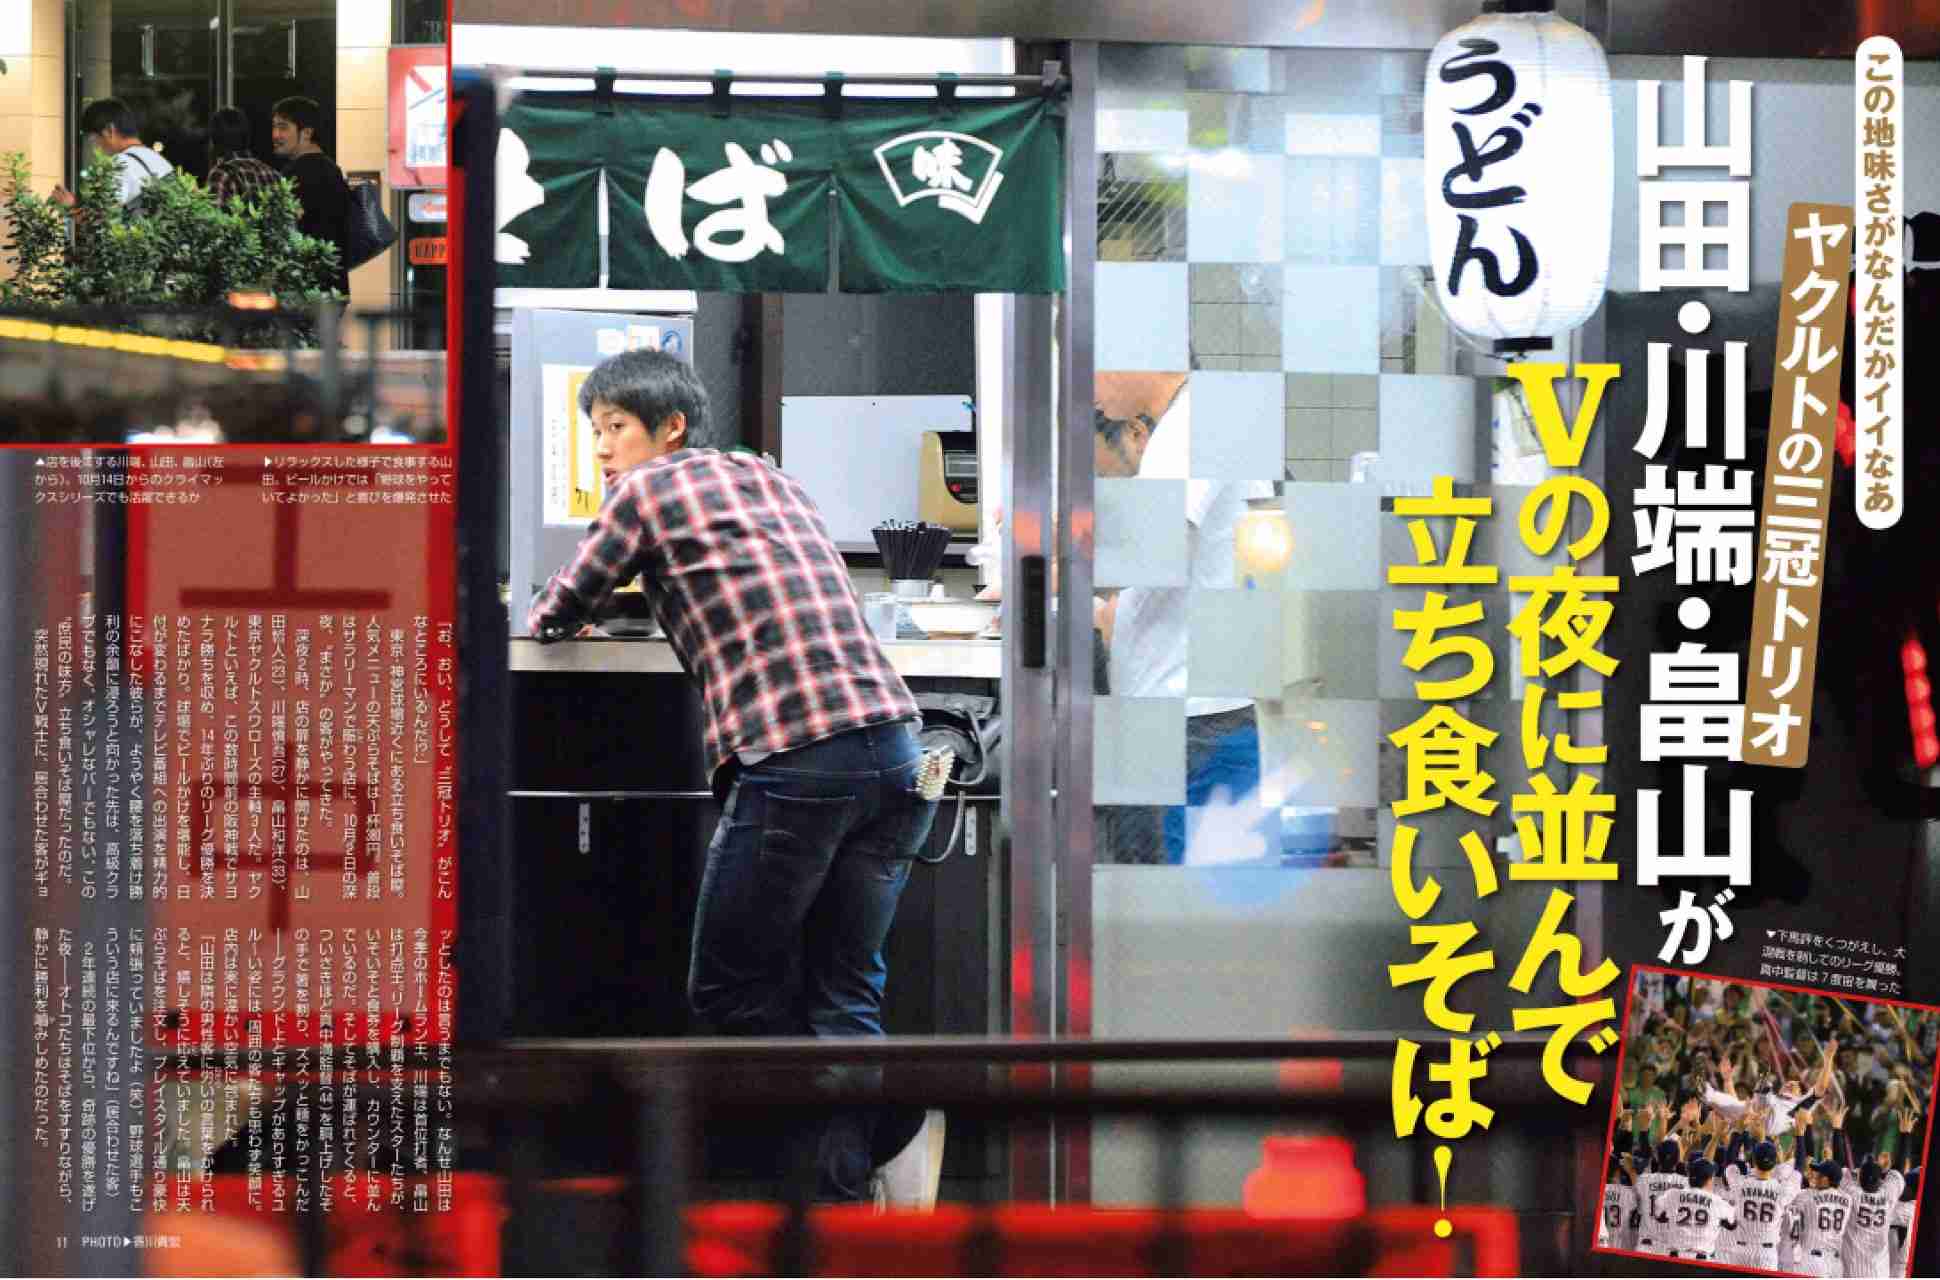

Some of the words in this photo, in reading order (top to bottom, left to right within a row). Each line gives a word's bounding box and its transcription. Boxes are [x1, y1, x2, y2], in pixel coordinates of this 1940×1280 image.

[912, 138, 974, 189] 味
[1440, 37, 1543, 297] うどん
[1676, 1205, 1710, 1227] 29
[1743, 1200, 1776, 1223] 66
[1818, 1206, 1845, 1231] 68
[1856, 1205, 1886, 1229] 53
